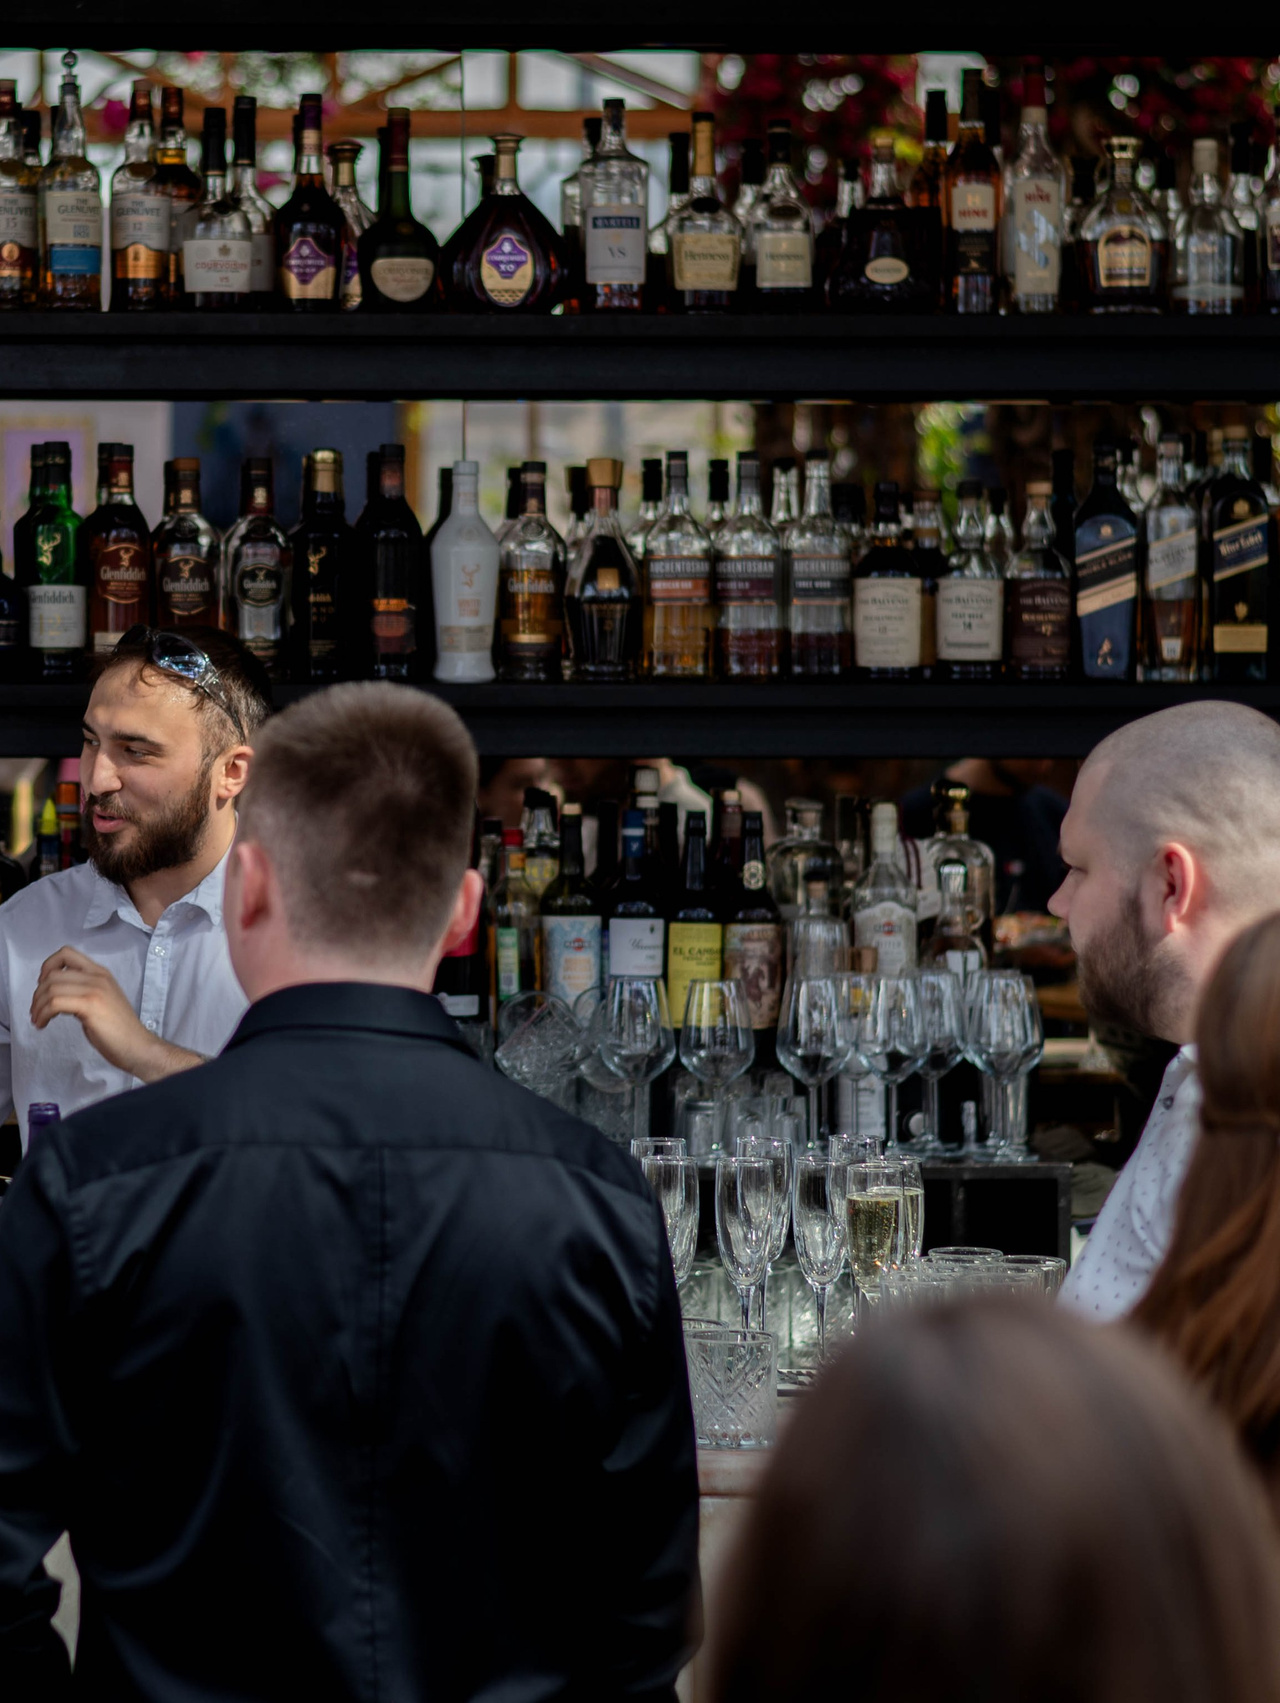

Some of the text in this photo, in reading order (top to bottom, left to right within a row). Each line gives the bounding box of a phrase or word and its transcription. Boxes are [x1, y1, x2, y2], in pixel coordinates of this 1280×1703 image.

[1025, 193, 1052, 203] HINE
[116, 208, 161, 217] GLENLIVET
[958, 209, 988, 219] HINE
[5, 217, 18, 228] 15
[684, 250, 730, 263] Hennessy
[499, 263, 515, 272] XO
[100, 566, 147, 581] Glenfiddich
[162, 577, 210, 593] Glenfiddich
